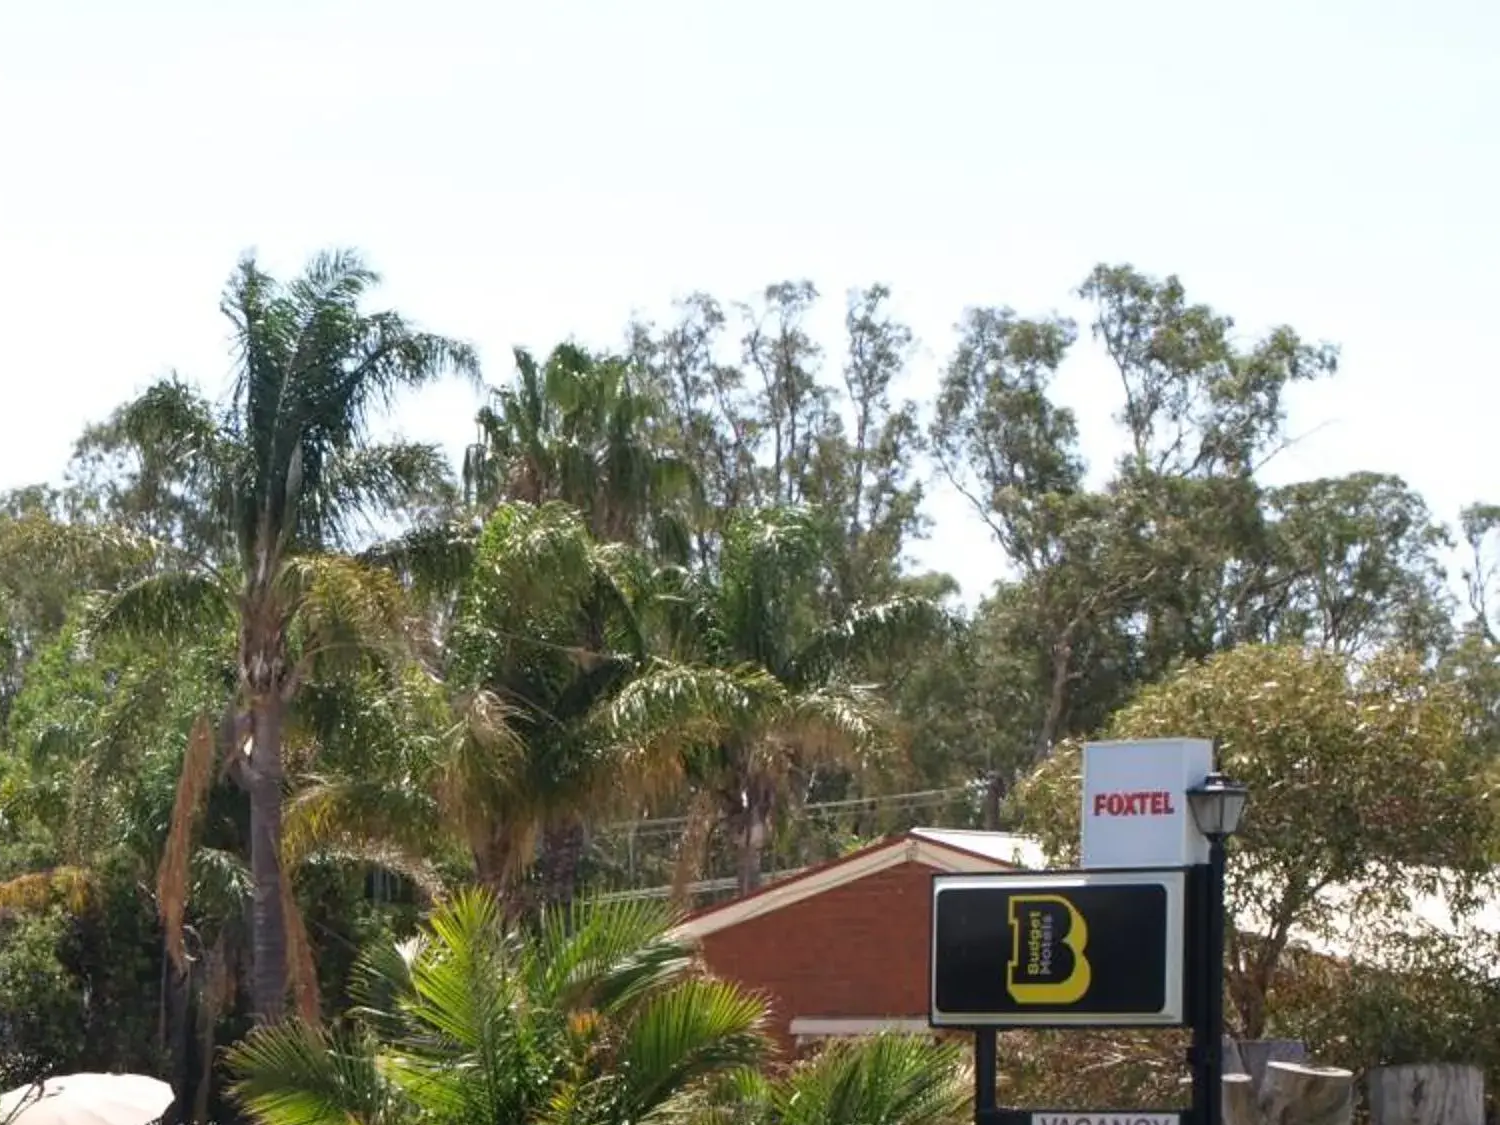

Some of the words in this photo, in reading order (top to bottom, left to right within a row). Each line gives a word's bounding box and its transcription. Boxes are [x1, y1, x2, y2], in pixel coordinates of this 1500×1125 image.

[1093, 791, 1175, 817] FOXTEL
[1027, 910, 1041, 976] Budget
[1040, 914, 1054, 976] Motels
